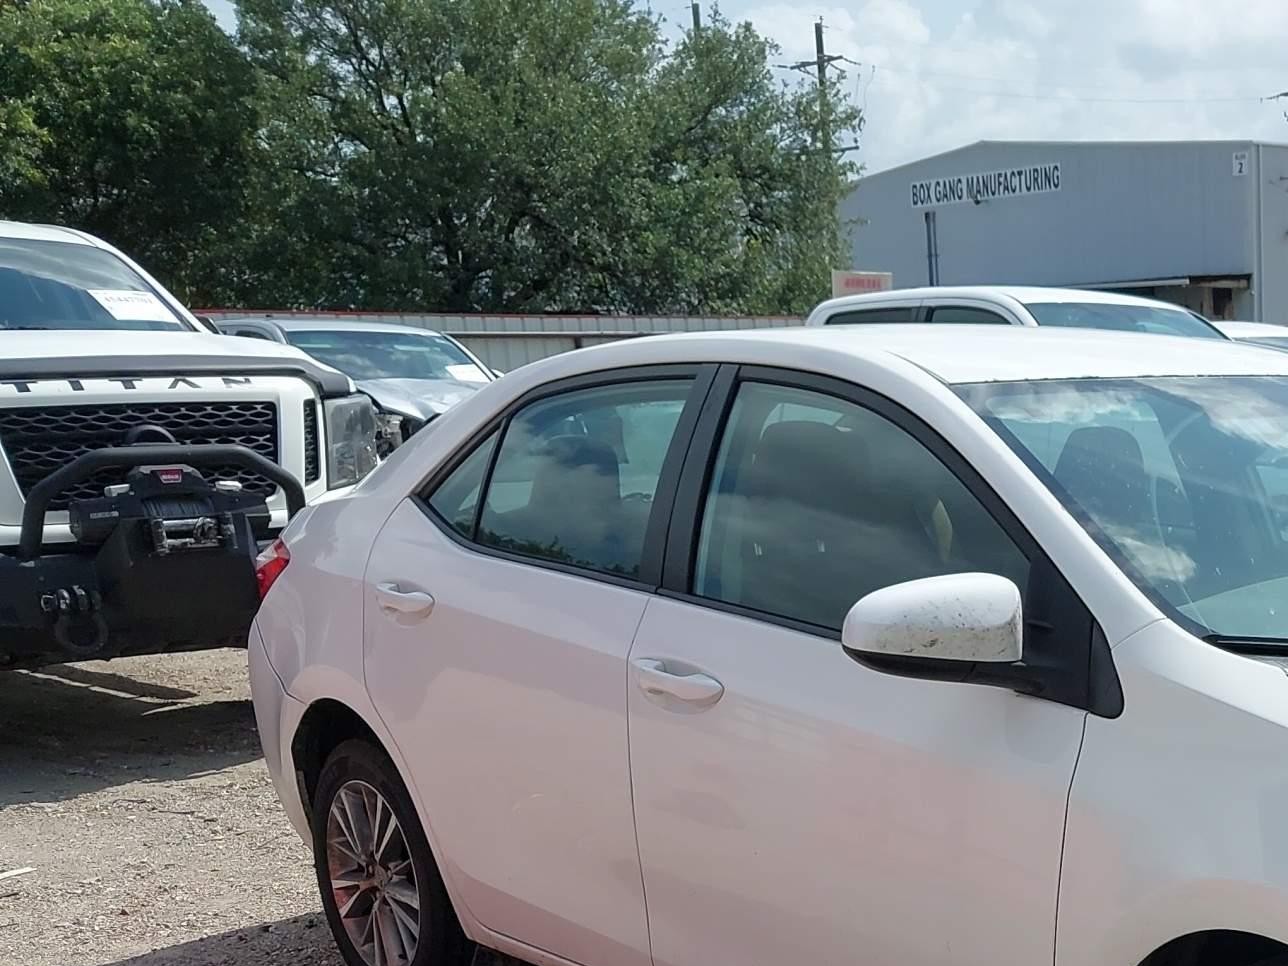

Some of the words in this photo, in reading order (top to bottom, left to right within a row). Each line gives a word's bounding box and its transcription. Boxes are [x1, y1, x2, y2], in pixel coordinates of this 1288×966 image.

[1237, 161, 1245, 174] 2
[911, 181, 933, 206] BOX
[934, 177, 963, 203] GANG
[966, 164, 1060, 200] MANUFACTURING
[0, 377, 252, 393] TITAN
